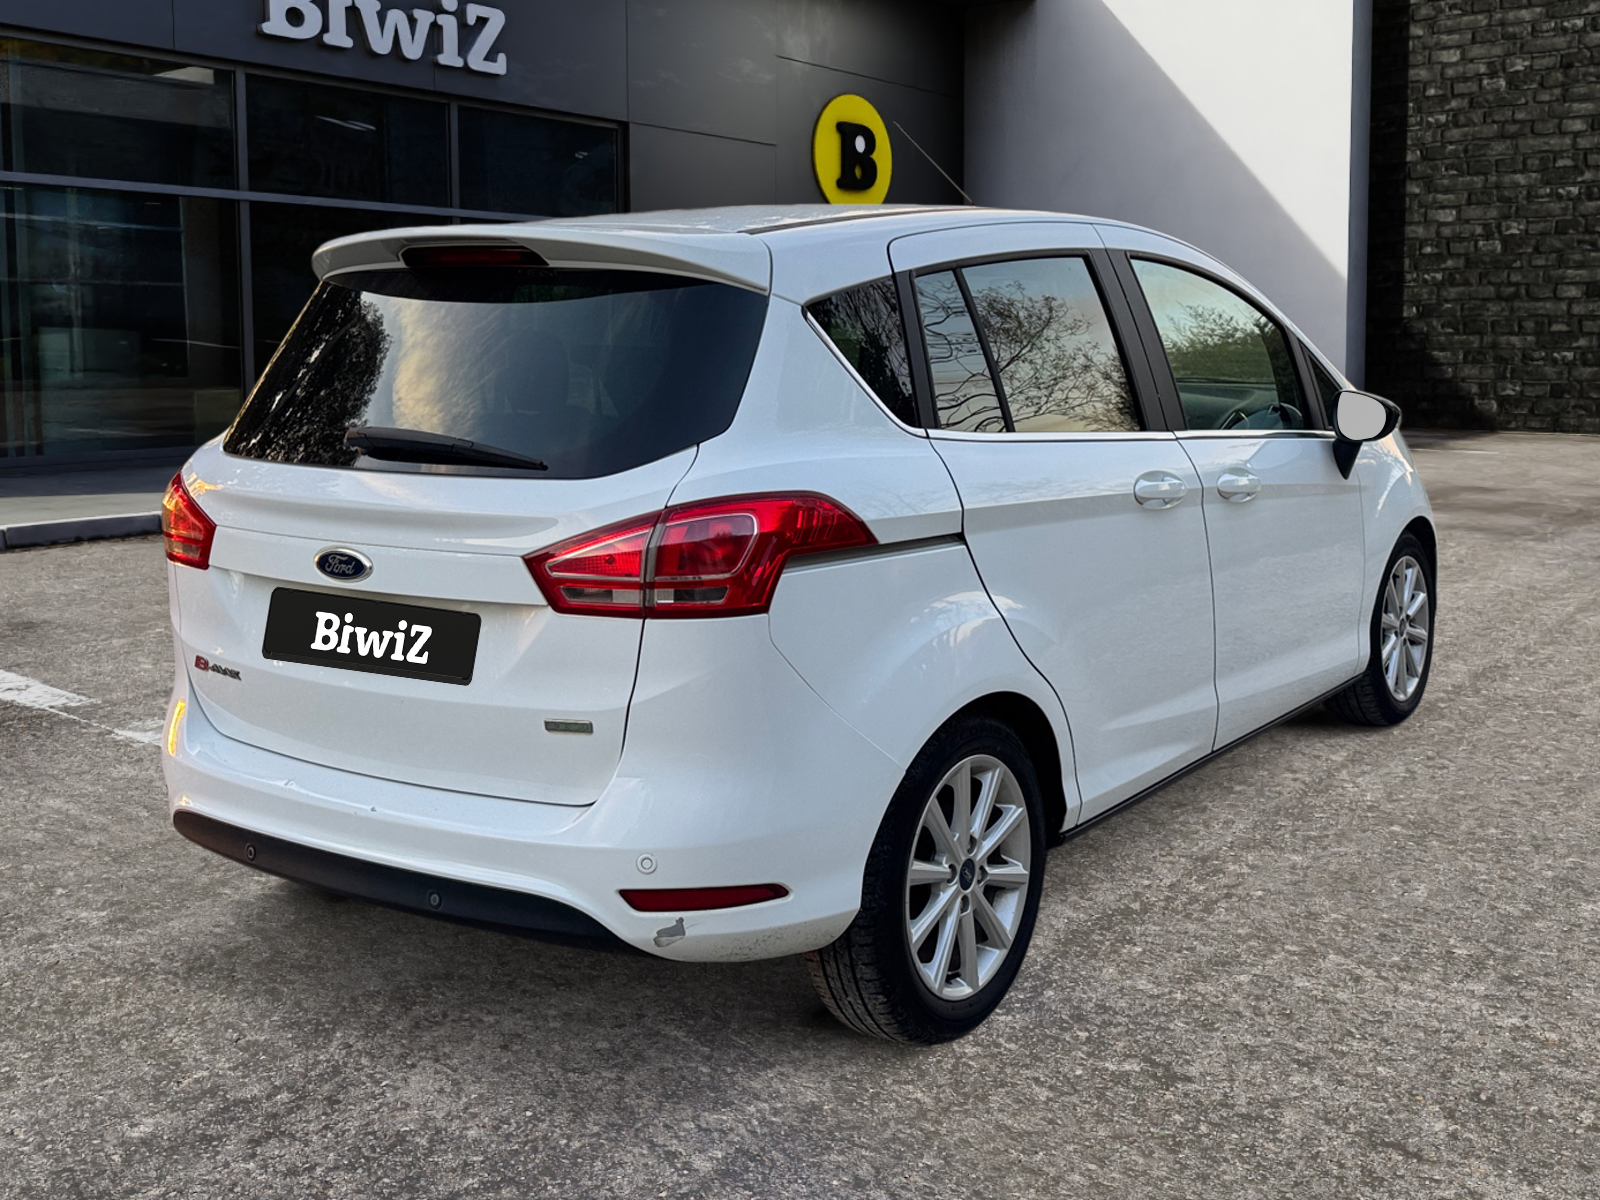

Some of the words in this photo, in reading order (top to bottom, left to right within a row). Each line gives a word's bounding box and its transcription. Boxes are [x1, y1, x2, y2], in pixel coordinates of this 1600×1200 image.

[836, 121, 878, 192] B
[325, 554, 356, 575] Ford
[310, 611, 433, 665] BiwiZ
